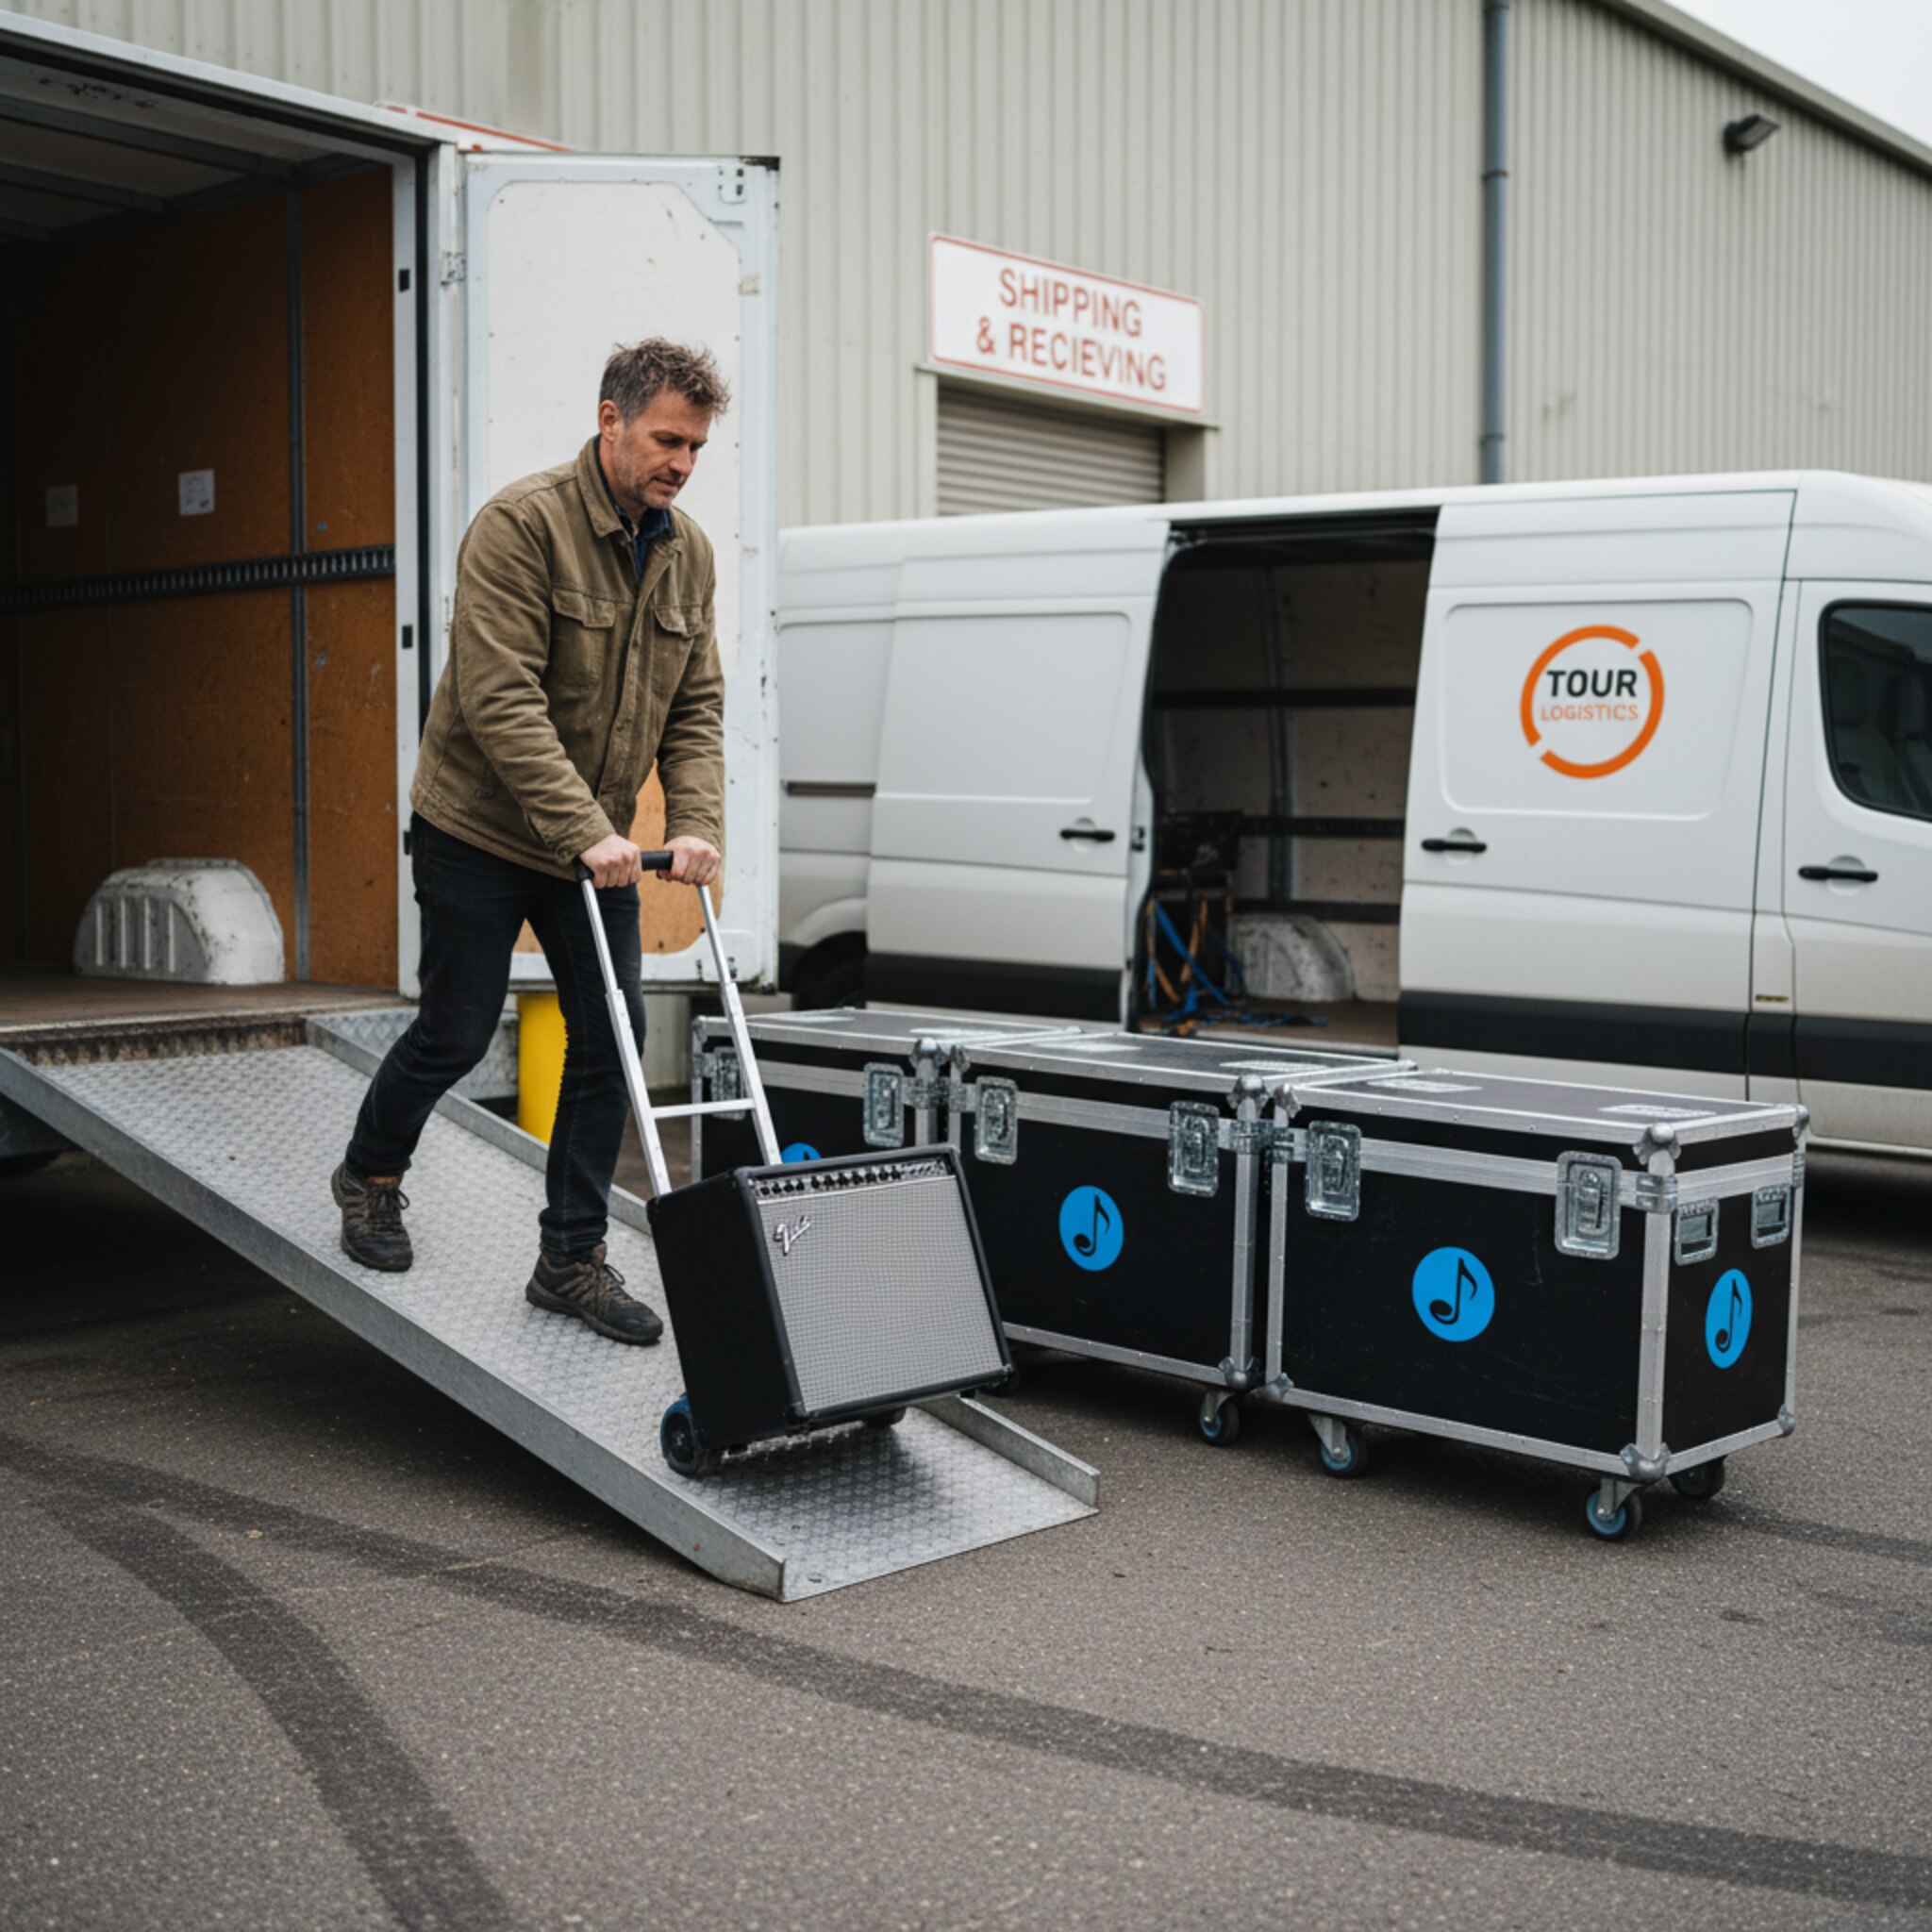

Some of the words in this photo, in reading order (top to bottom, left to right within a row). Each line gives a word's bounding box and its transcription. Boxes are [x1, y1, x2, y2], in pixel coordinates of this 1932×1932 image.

[1000, 268, 1141, 337] SHIPPING
[976, 316, 995, 354] &
[1008, 323, 1166, 391] RECIEVING
[1546, 669, 1638, 698] TOUR
[1541, 704, 1639, 721] LOGISTICS
